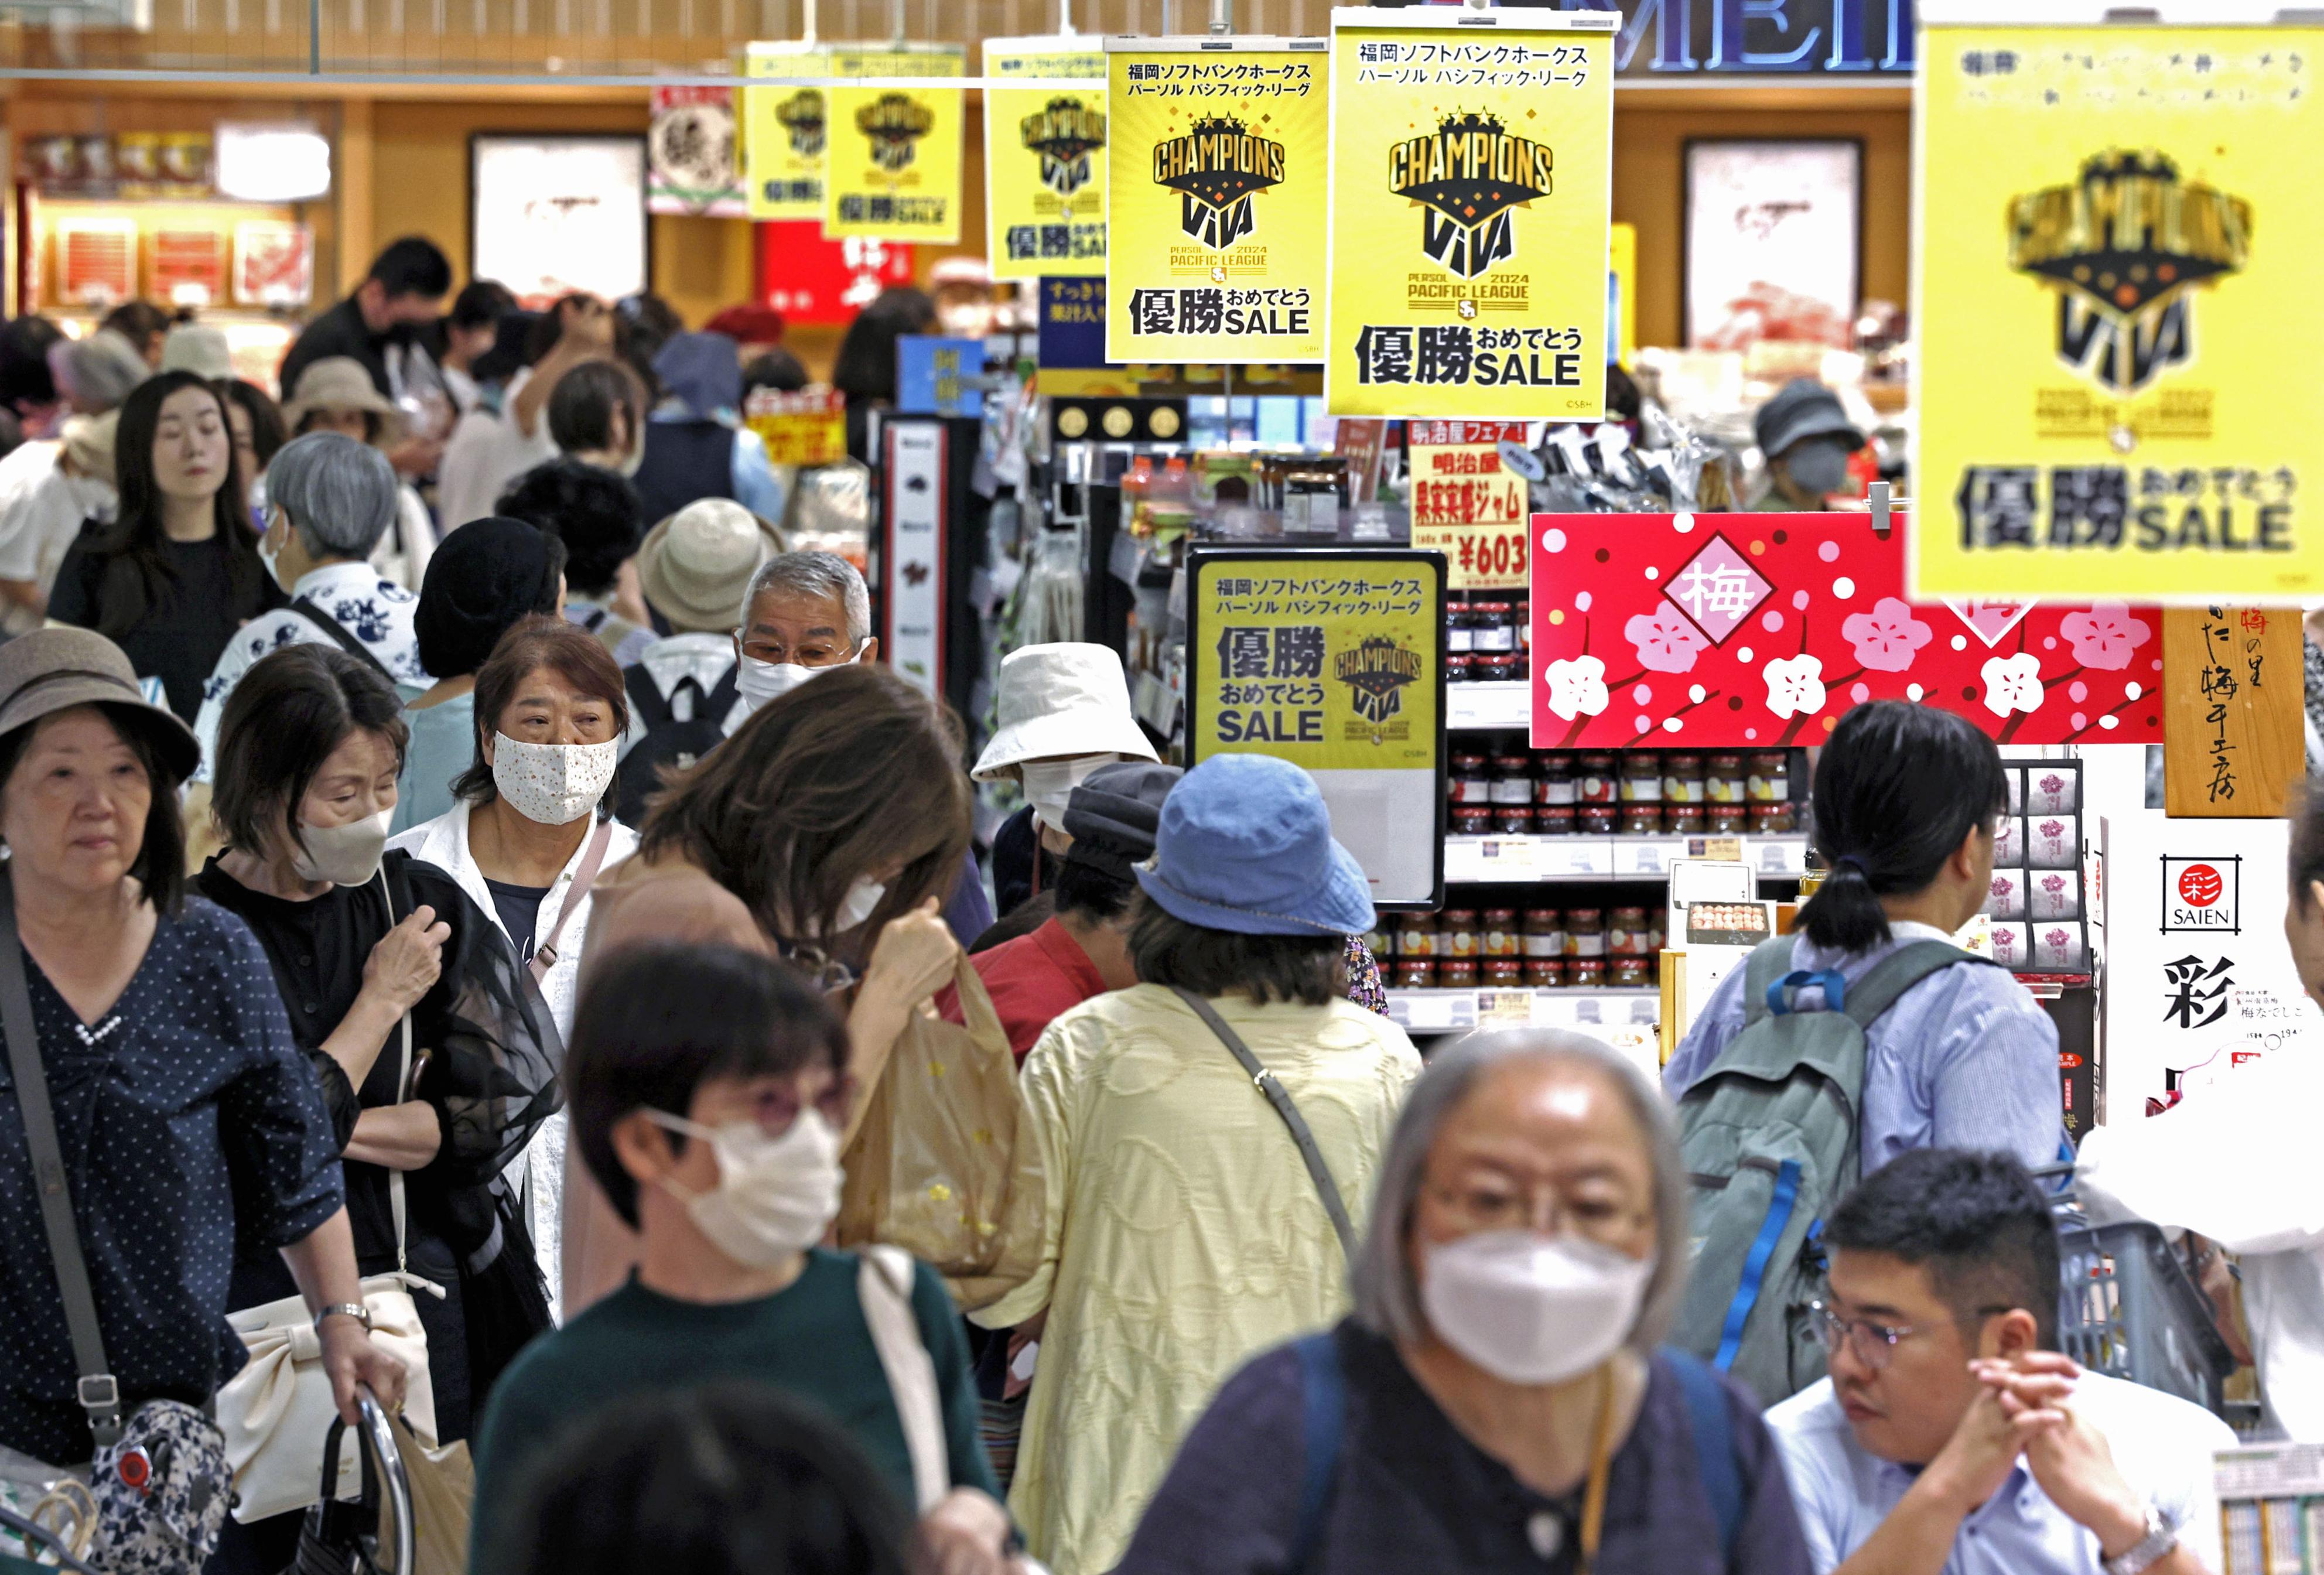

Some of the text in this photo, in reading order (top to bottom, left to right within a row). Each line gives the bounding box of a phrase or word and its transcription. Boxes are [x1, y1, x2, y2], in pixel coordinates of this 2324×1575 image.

[1359, 44, 1587, 64] 福岡ソフトバンクホークス
[1128, 64, 1311, 80] 福岡ソフトバンクホークス
[1128, 84, 1184, 97] パーソル
[1154, 133, 1284, 184] CHAMPIONS
[1390, 132, 1553, 195] CHAMPIONS
[1171, 255, 1267, 265] PACIFIC LEAGUE
[1408, 285, 1529, 299] PACIFIC LEAGUE
[1409, 274, 1529, 283] PERSOL 2024
[1129, 288, 1310, 334] 優勝 おめでとう
[1225, 309, 1309, 334] SALE
[1355, 325, 1581, 384] 優勝 おめでとう
[1474, 353, 1580, 385] SALE
[1433, 452, 1502, 474] 明治屋
[1956, 464, 2128, 552] 優勝
[2137, 504, 2295, 552] SALE
[1458, 534, 1526, 575] ¥603
[1216, 579, 1423, 596] 福岡ソフトバンクホークス
[1680, 562, 1755, 620] 梅
[1216, 600, 1279, 614] パーソル
[1216, 626, 1326, 679] 優勝
[1335, 648, 1422, 680] CHAMPIONS
[1219, 684, 1324, 705] おめでとう
[1217, 710, 1324, 743] SALE
[2183, 872, 2220, 901] 彩
[2174, 908, 2229, 925] SAIEN
[2163, 954, 2236, 1029] 彩
